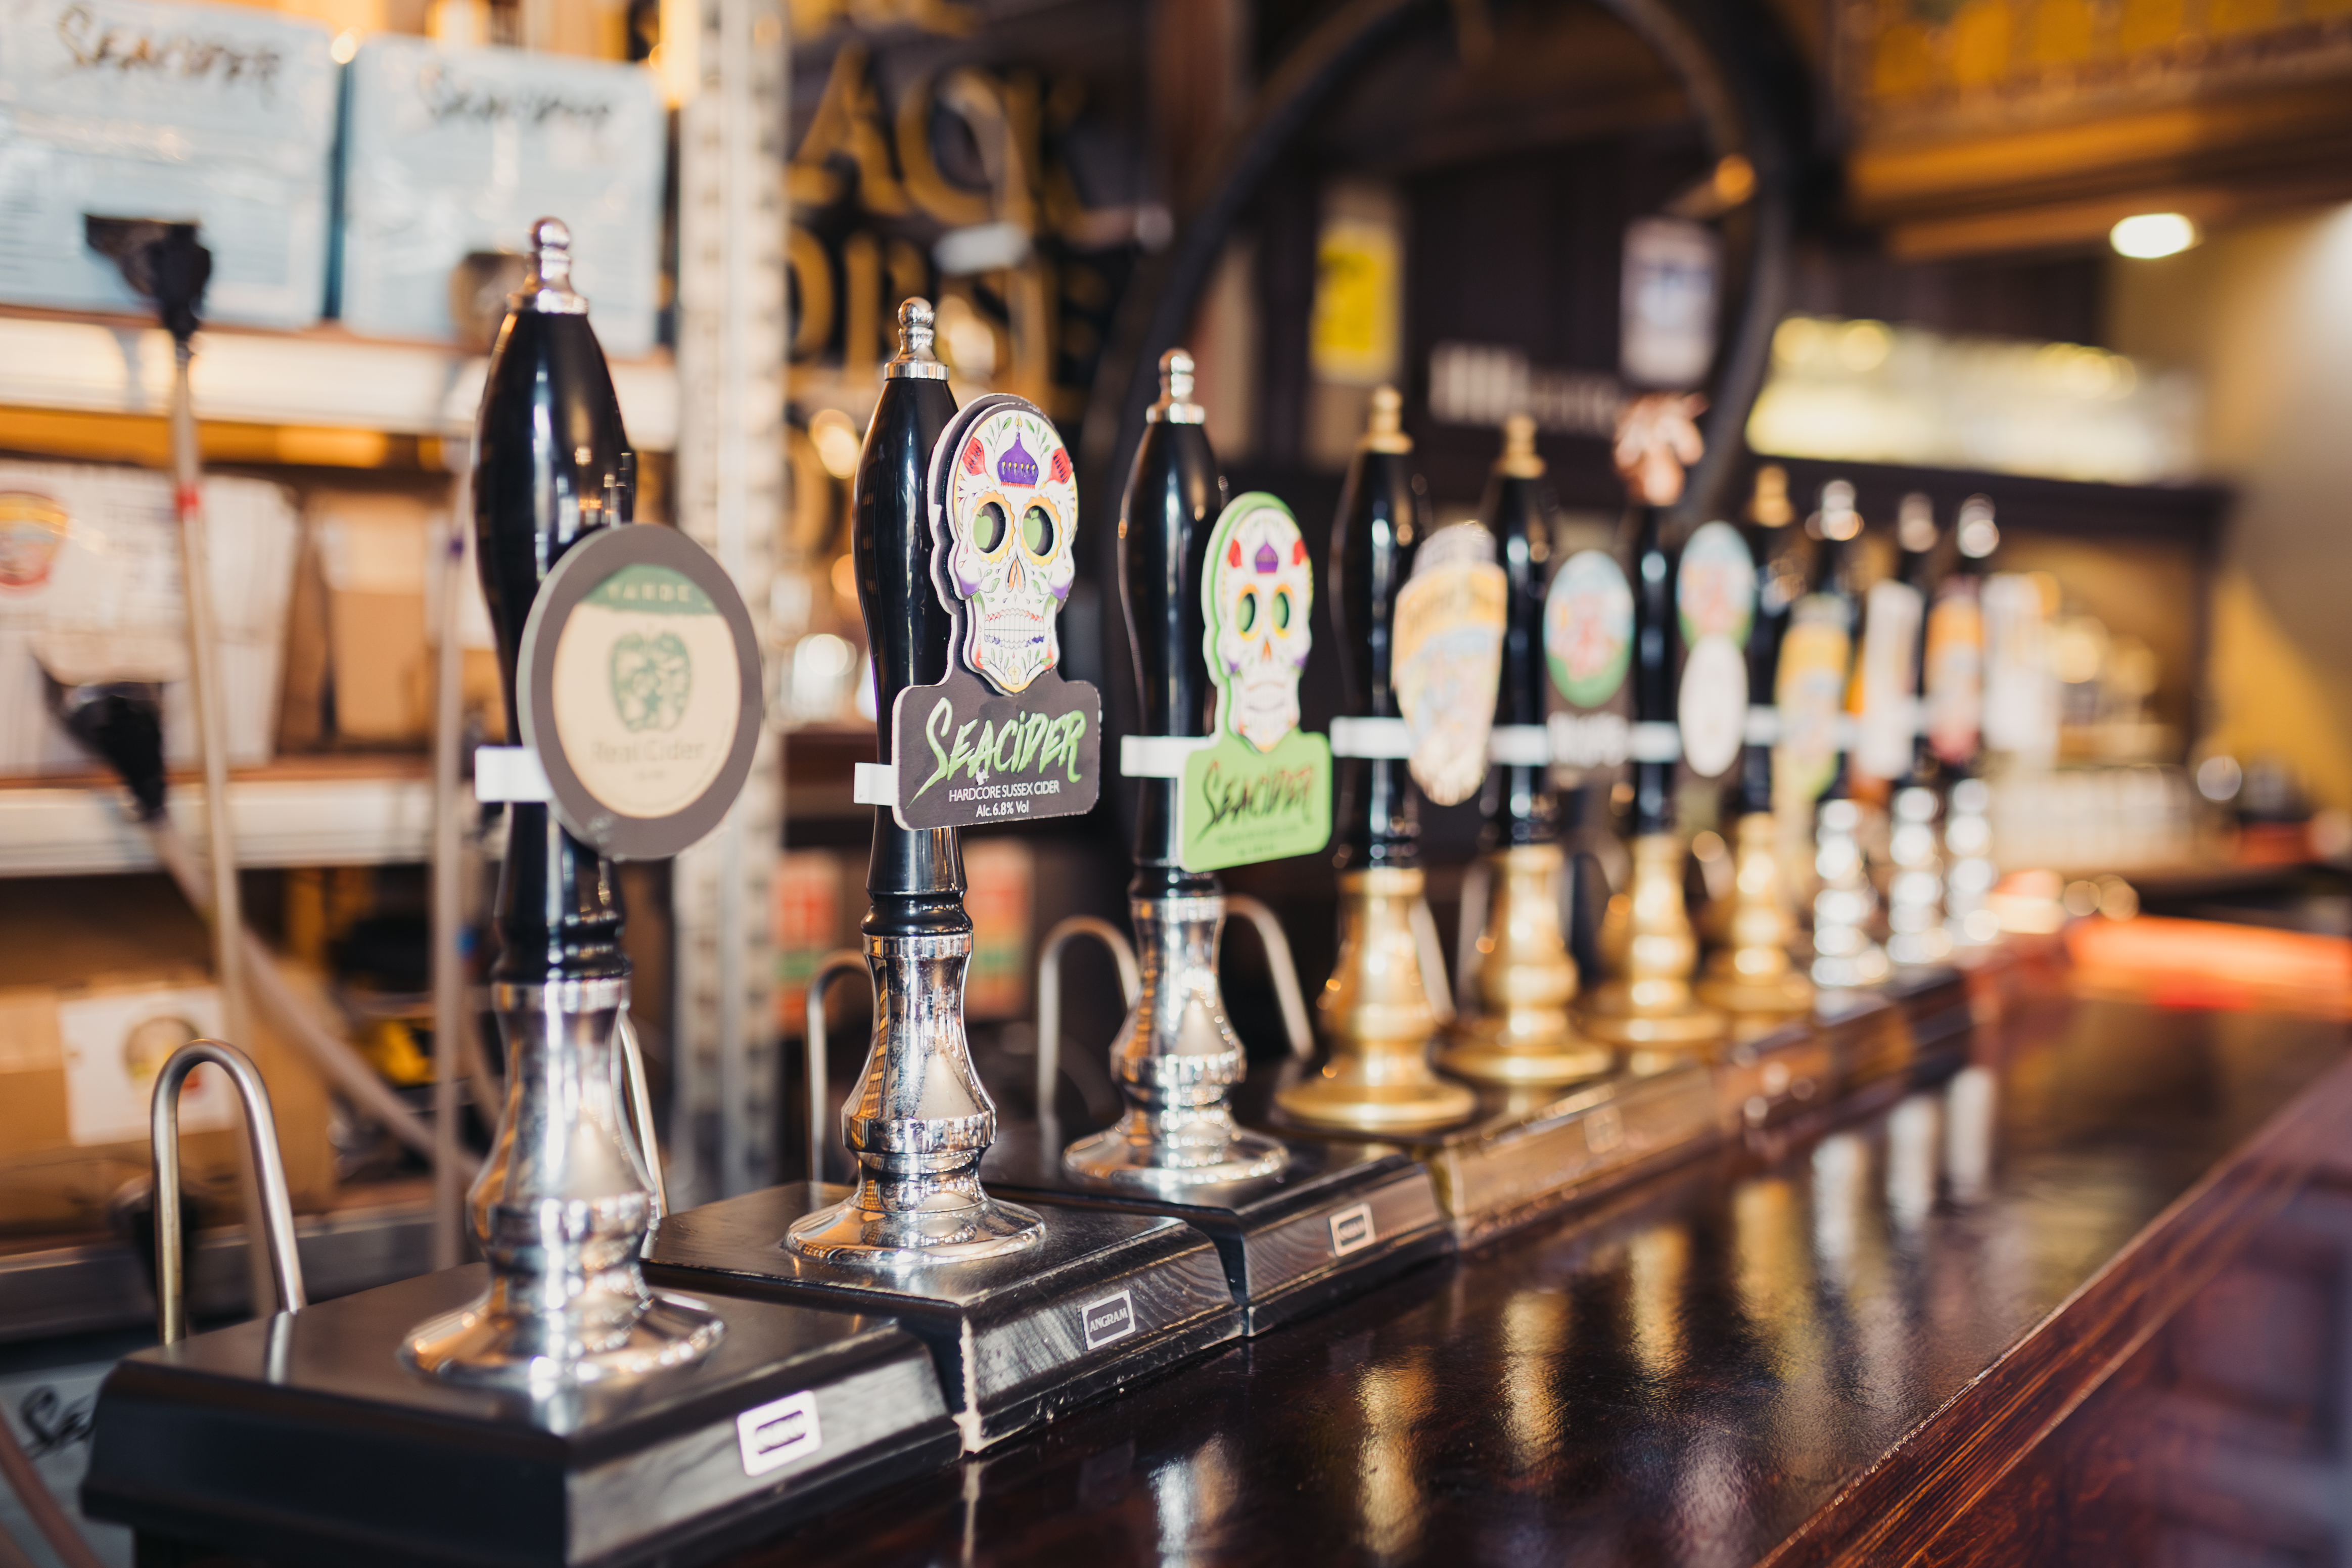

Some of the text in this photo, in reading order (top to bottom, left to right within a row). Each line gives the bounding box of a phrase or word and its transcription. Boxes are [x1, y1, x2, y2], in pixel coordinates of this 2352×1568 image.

[949, 779, 1060, 802] HARDCORE SUSSEX CIDER
[1015, 800, 1029, 813] Vol
[1089, 1307, 1128, 1333] ANGRAM
